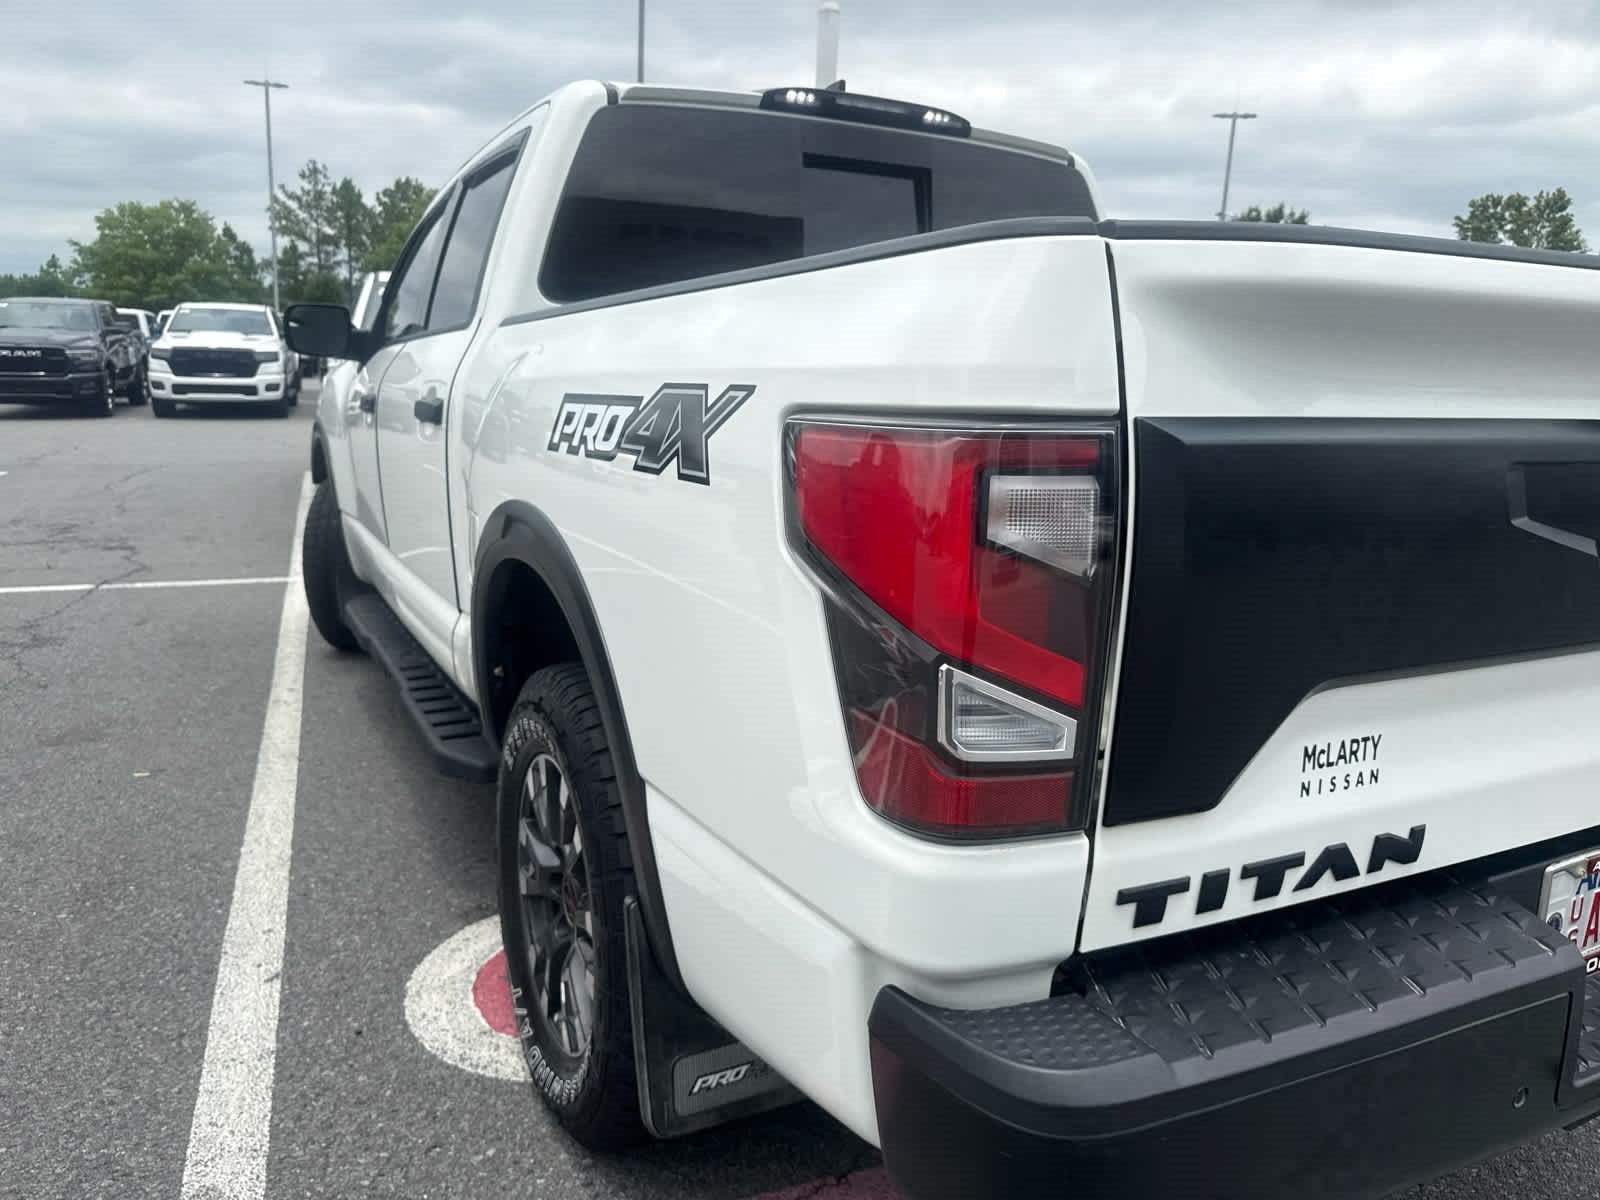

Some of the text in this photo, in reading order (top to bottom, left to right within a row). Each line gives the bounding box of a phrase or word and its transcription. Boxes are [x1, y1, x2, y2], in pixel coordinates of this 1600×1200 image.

[1302, 734, 1382, 773] McLARTY
[1300, 768, 1379, 798] NISSAN
[1116, 824, 1426, 929] TITAN
